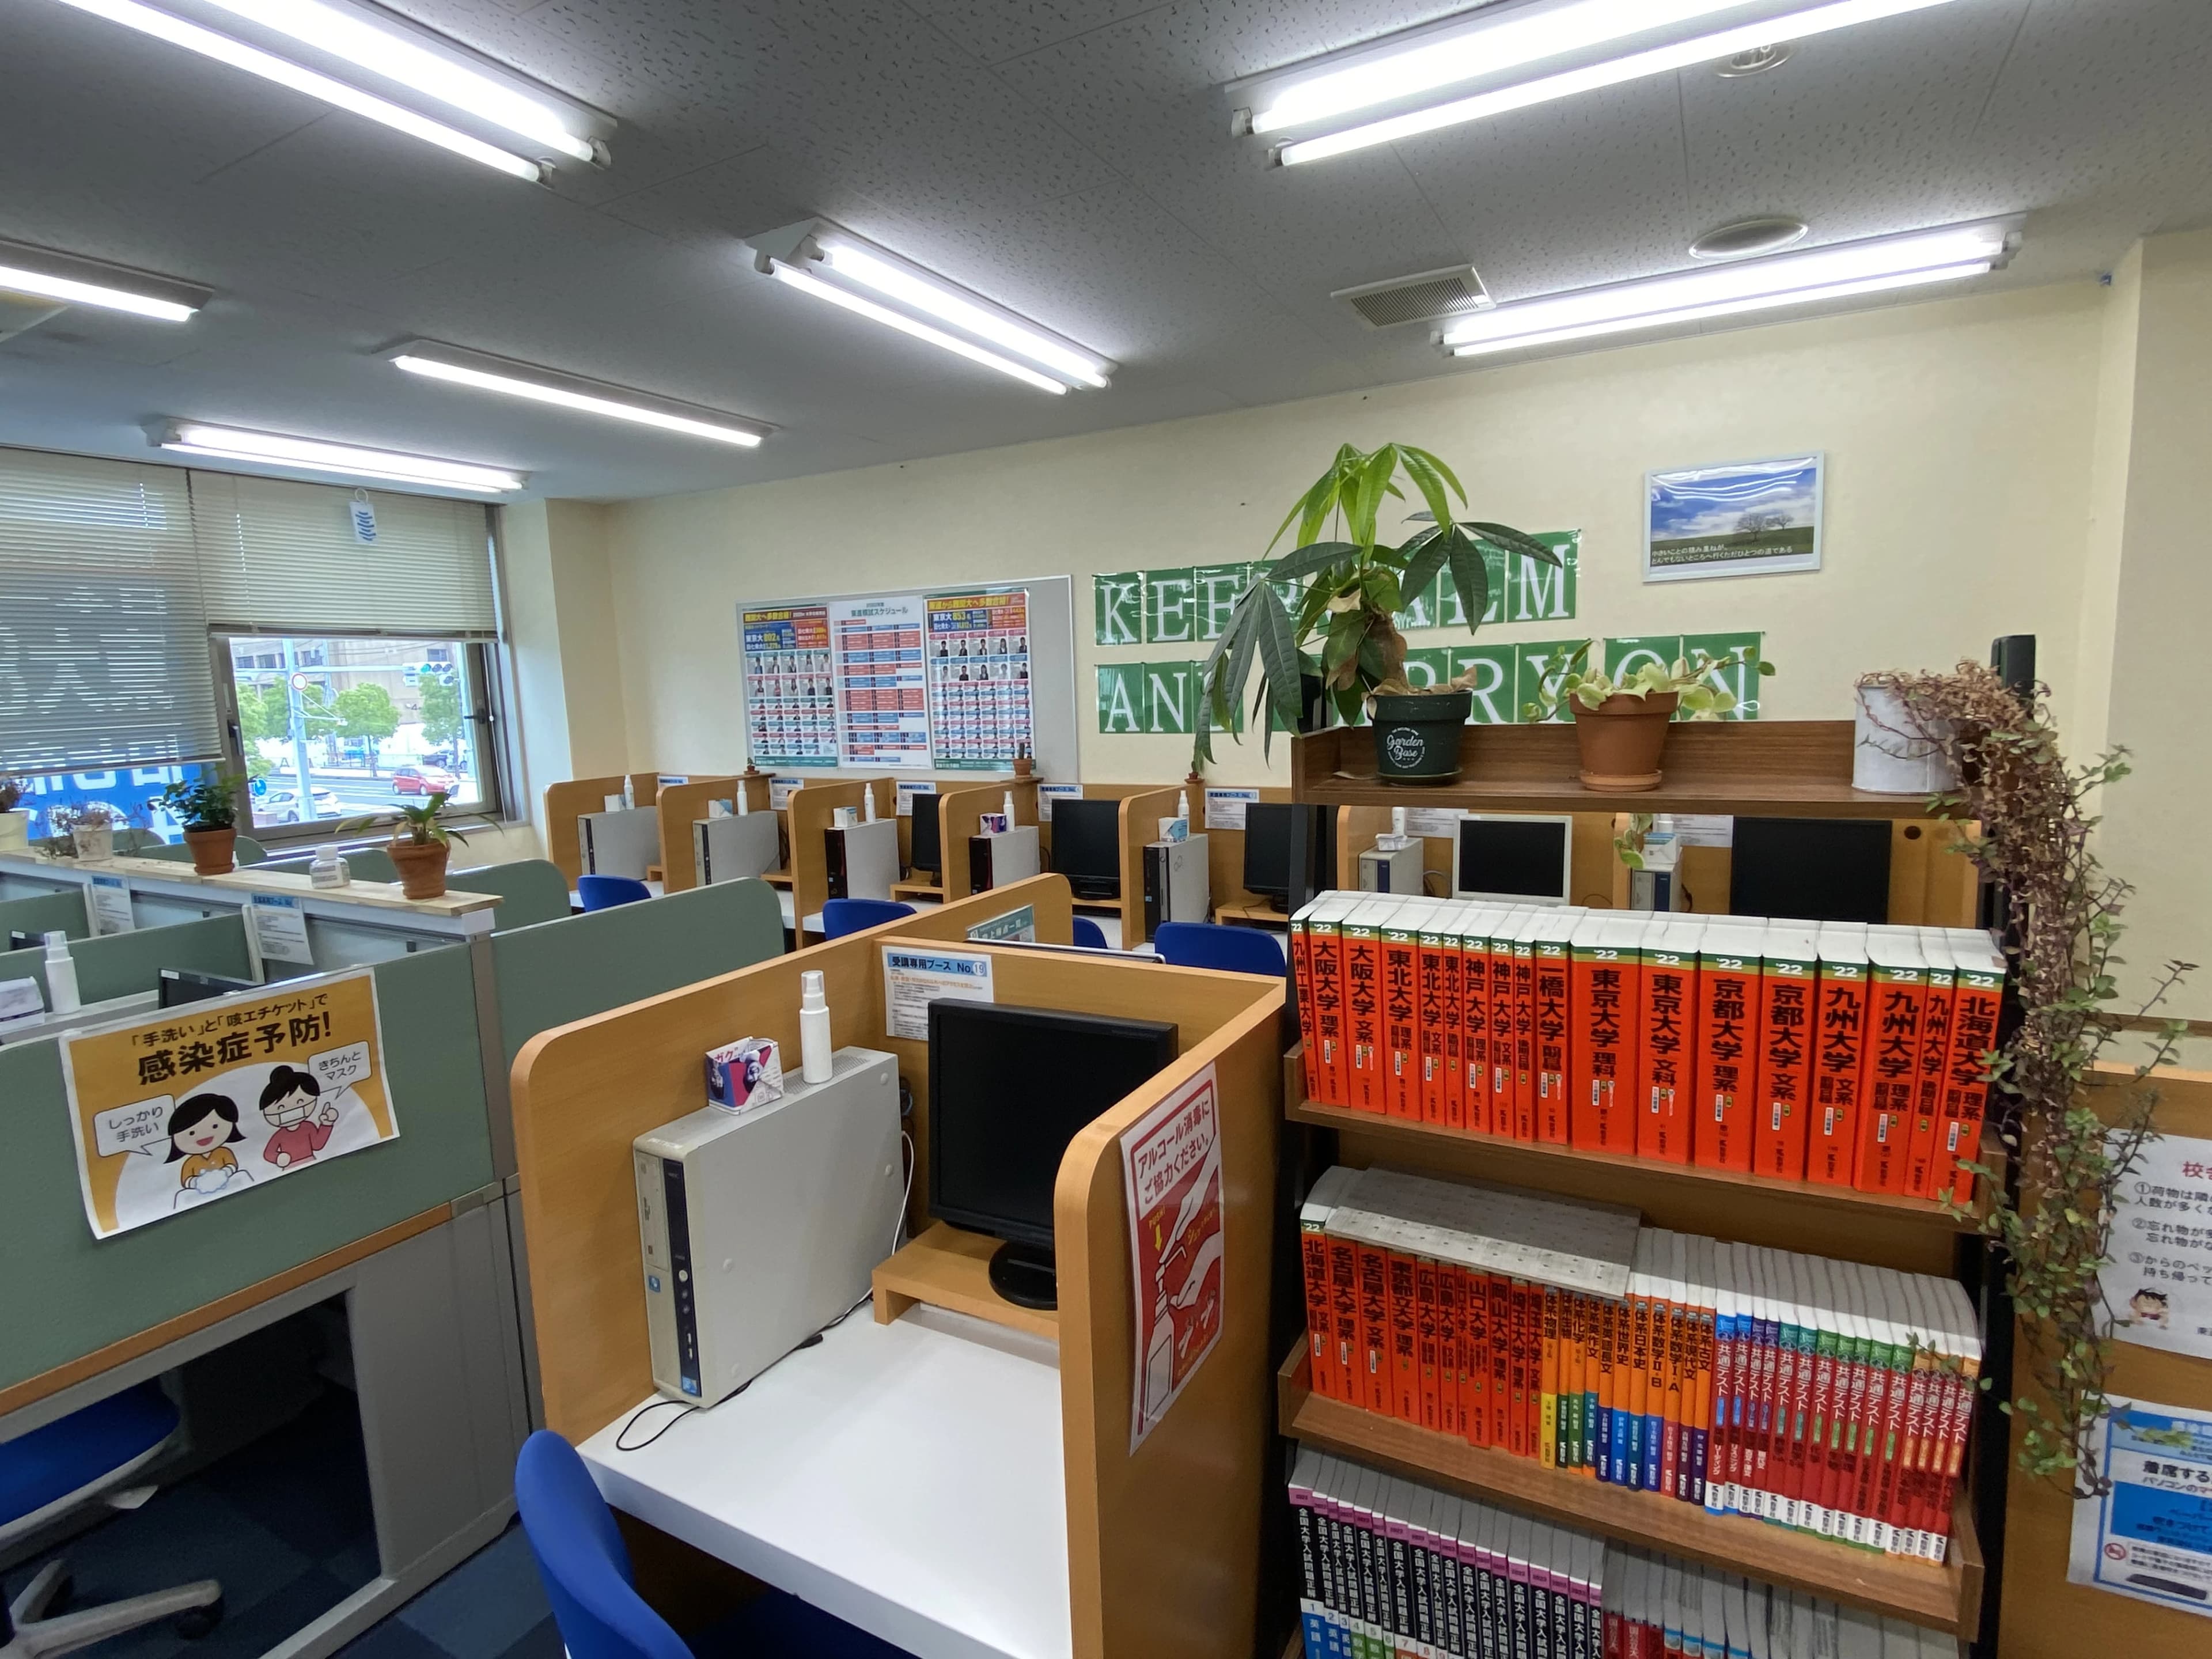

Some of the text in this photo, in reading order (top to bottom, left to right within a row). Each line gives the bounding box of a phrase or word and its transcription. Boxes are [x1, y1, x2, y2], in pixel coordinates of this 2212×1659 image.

[1100, 571, 1297, 644] KEE
[1387, 734, 1424, 751] Garden
[1393, 745, 1418, 761] Base
[892, 956, 952, 971] 受講専用ブース
[1313, 941, 1340, 1038] 大阪大学 理系
[1387, 950, 1413, 1022] 東北大学
[1445, 956, 1460, 1029] 東北大学
[131, 993, 329, 1047] 「手洗い」と「咳エチケット」で
[1350, 945, 1376, 1044] 大阪大学 文系
[1422, 954, 1442, 1056] 東北大学 文系
[1465, 959, 1486, 1062] 神戸大学 理系
[1493, 961, 1512, 1066] 神戸大学 文系
[1516, 965, 1531, 1035] 神戸大学
[1539, 967, 1565, 1041] 一橋大学
[1590, 969, 1622, 1078] 東京大学 理科
[138, 1011, 331, 1085] 感染症予防!
[1650, 974, 1683, 1086] 東京大学 文科
[1710, 978, 1746, 1093] 京都大学 理系
[1768, 984, 1806, 1102] 京都大学 文系
[1821, 987, 1861, 1106] 九州大学 文系
[1877, 991, 1919, 1112] 九州大学 理系
[1922, 995, 1949, 1075] 九州大学
[1950, 996, 1997, 1121] 北海道大学 理系
[318, 1050, 362, 1071] きちんと
[325, 1065, 358, 1081] マスク
[108, 1105, 164, 1130] しっかり
[115, 1122, 160, 1142] 手洗い
[1138, 1100, 1210, 1179] アルコール消毒に
[1145, 1133, 1209, 1205] ご協力ください。
[2134, 1181, 2212, 1203] ①荷物は順
[1304, 1239, 1328, 1307] 北海道大学
[1331, 1246, 1356, 1315] 名古屋大学
[1360, 1253, 1385, 1323] 名古屋大学
[1419, 1269, 1435, 1339] 広島大学
[1440, 1272, 1456, 1342] 広島大学
[1457, 1274, 1467, 1332] 山口大学
[1469, 1281, 1487, 1341] 山口大学
[1492, 1282, 1509, 1354] 岡山大学
[1573, 1298, 1585, 1344] 体系化学
[1587, 1300, 1601, 1359] 体系英作文
[1616, 1305, 1631, 1366] 体系世界史
[1633, 1310, 1649, 1370] 体系日本史
[1684, 1321, 1698, 1380] 体系現代文
[1698, 1323, 1713, 1372] 体系古文
[1716, 1344, 1731, 1396] 共通テスト
[1733, 1343, 1748, 1396] 共通テスト
[1749, 1348, 1762, 1401] 共通テスト
[1761, 1350, 1775, 1402] 共通テスト
[1777, 1353, 1794, 1406] 共通テスト
[1796, 1358, 1813, 1411] 共通テスト
[1815, 1360, 1832, 1414] 共通テスト
[1833, 1366, 1850, 1420] 共通テスト
[1849, 1368, 1867, 1422] 共通テスト
[1866, 1372, 1885, 1426] 共通テスト
[1888, 1375, 1907, 1430] 共通テスト
[1906, 1382, 1926, 1437] 共通テスト
[1922, 1384, 1942, 1438] 共通テスト
[1938, 1385, 1957, 1440] 共通テスト
[1953, 1388, 1973, 1444] 共通テスト
[1310, 1603, 1315, 1611] 1
